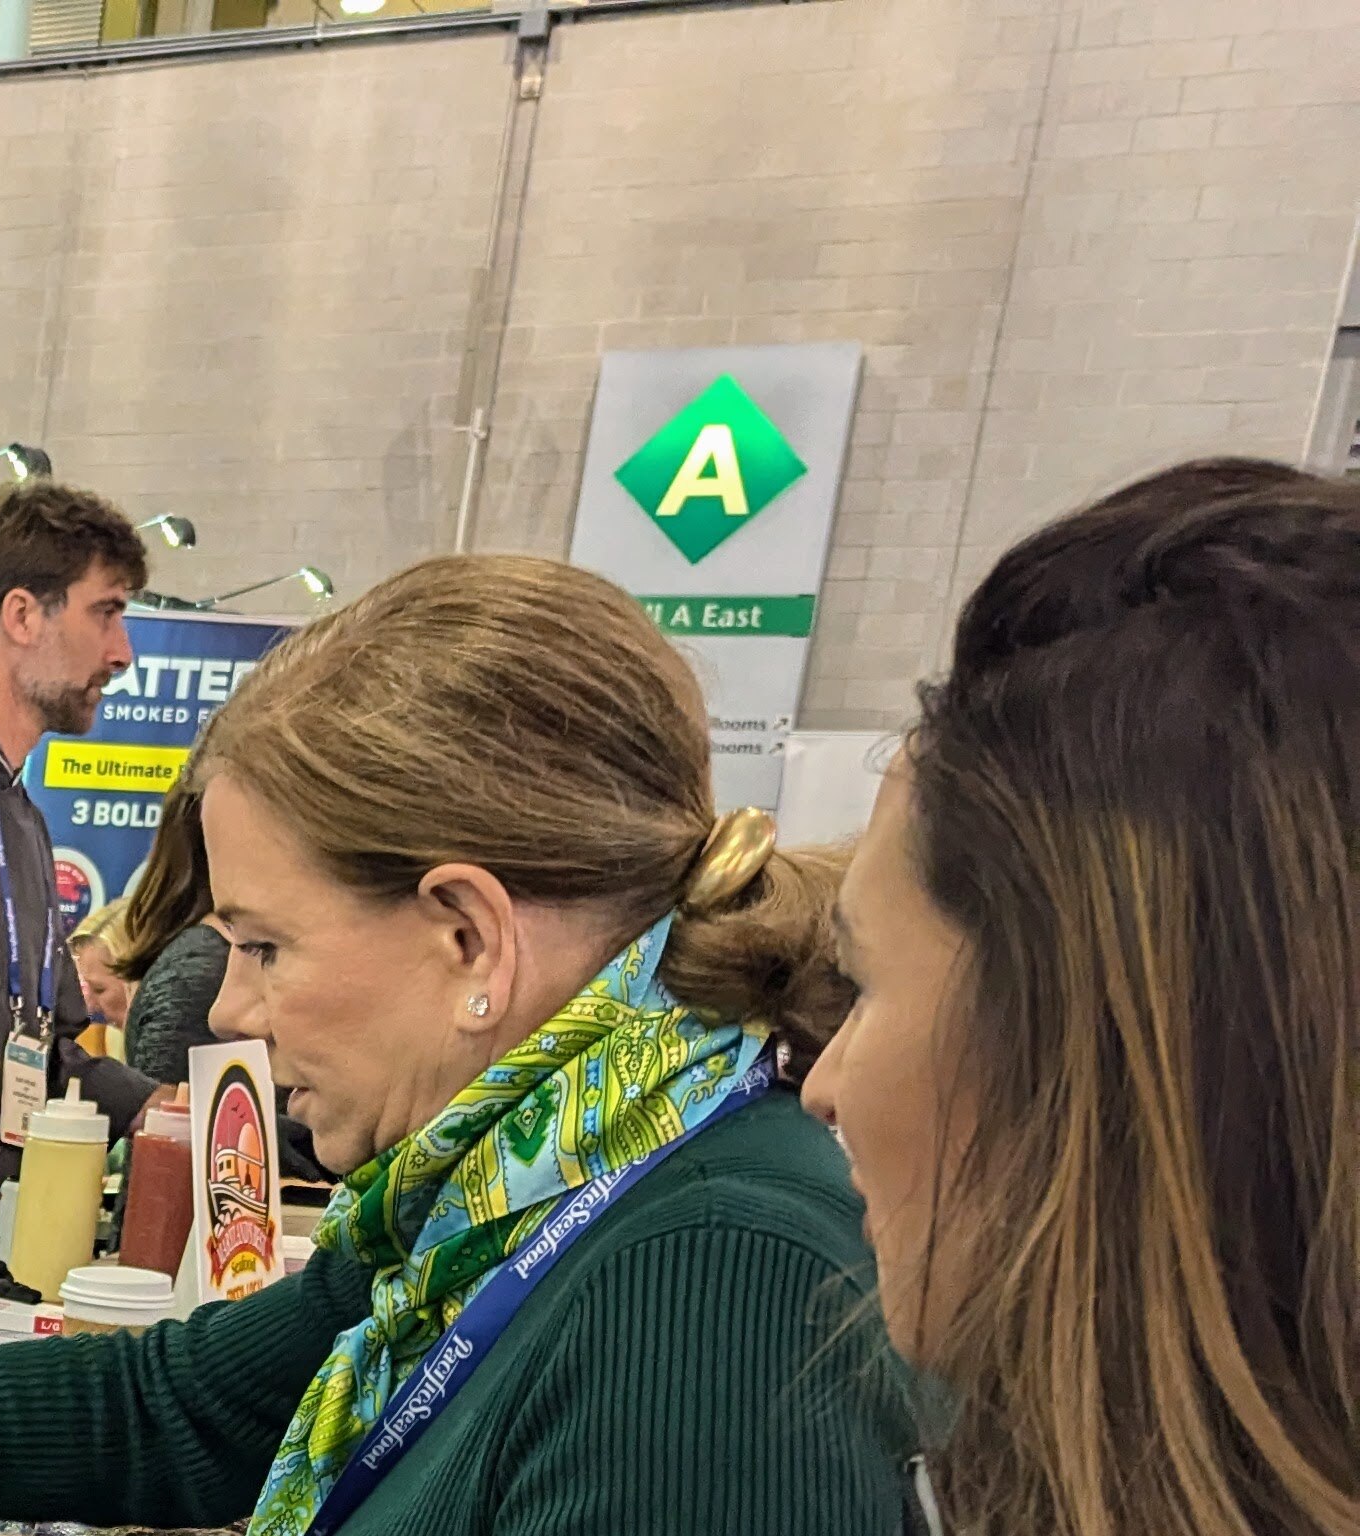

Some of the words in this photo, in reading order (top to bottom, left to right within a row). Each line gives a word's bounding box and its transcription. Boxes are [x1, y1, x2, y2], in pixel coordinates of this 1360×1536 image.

[655, 423, 750, 516] A
[670, 603, 691, 627] A
[702, 603, 764, 628] East
[103, 703, 189, 724] SMOKED
[61, 757, 92, 776] The
[96, 759, 173, 779] Ultimate
[71, 800, 90, 825] 3
[93, 801, 161, 829] BOLD
